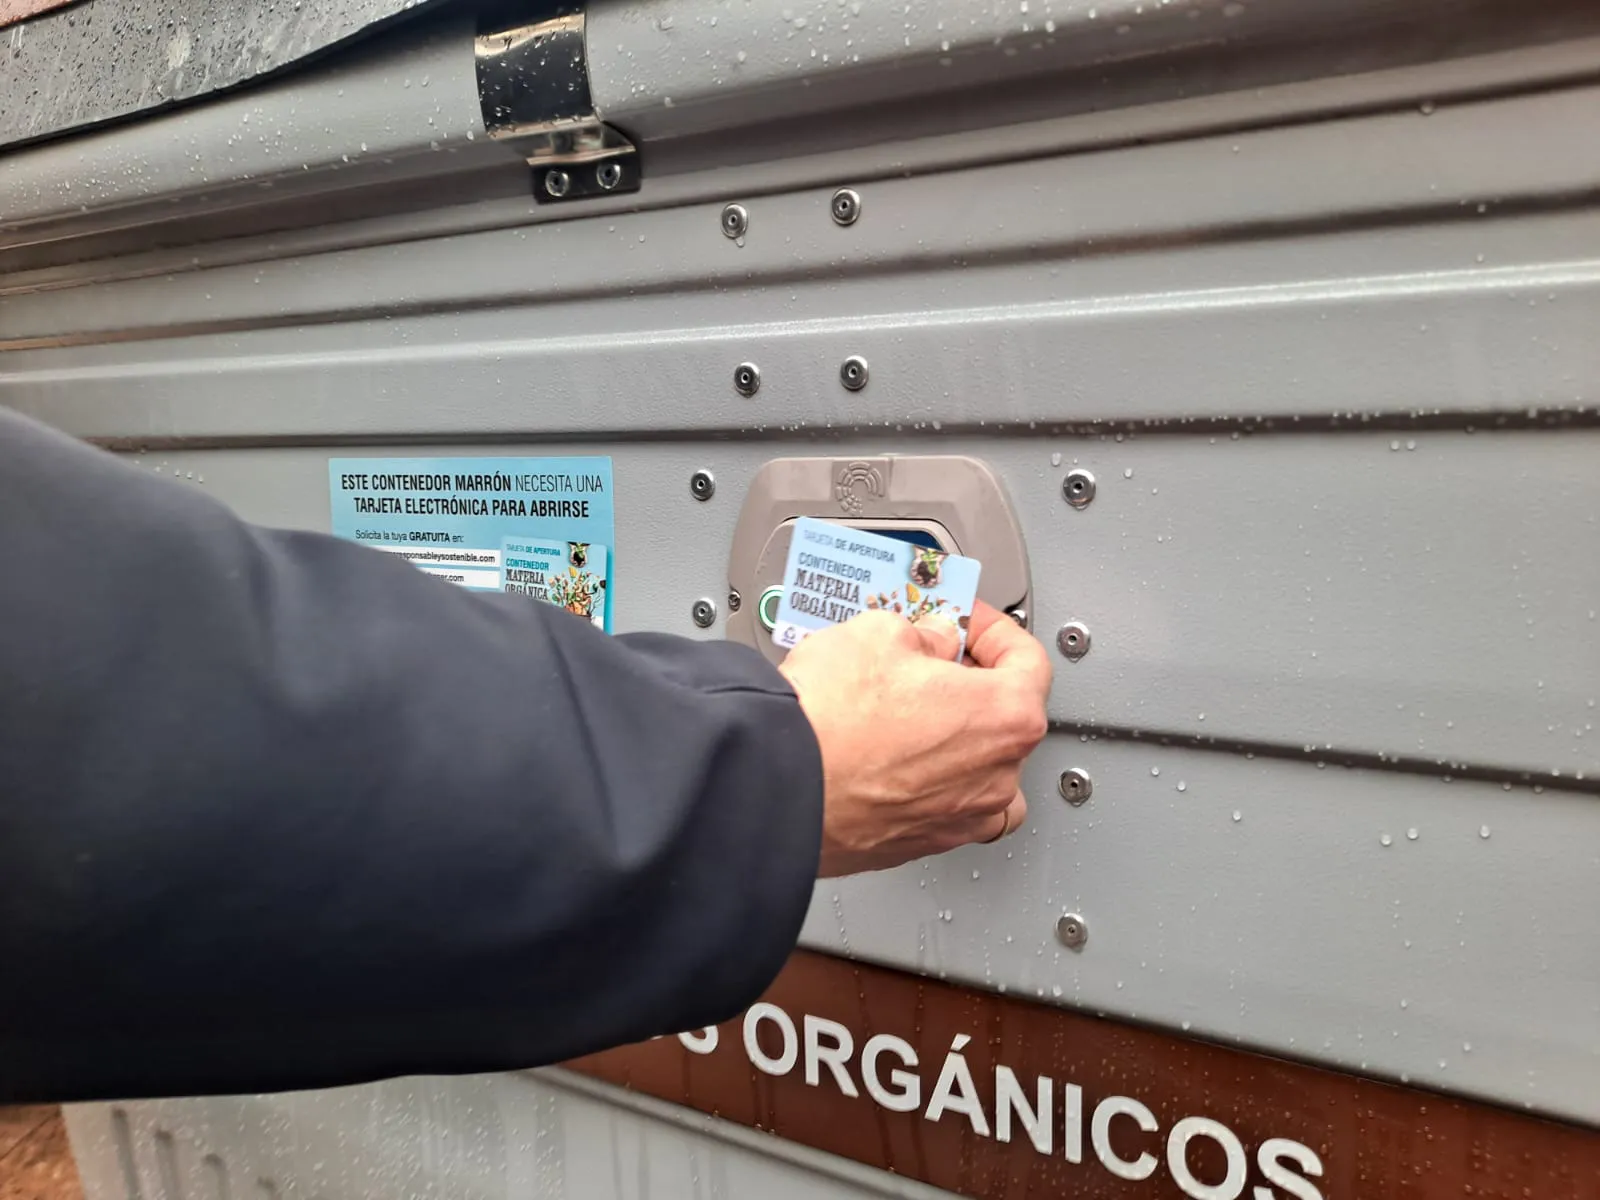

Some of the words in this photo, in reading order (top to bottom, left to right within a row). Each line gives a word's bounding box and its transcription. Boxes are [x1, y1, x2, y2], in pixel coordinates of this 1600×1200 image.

[341, 474, 368, 490] ESTE
[372, 474, 451, 491] CONTENEDOR
[455, 471, 511, 492] MARRÓN
[515, 474, 573, 492] NECESITA
[577, 475, 603, 493] UNA
[354, 497, 401, 514] TARJETA
[405, 495, 488, 516] ELECTRÓNICA
[492, 500, 526, 517] PARA
[530, 501, 589, 518] ABRIRSE
[355, 530, 382, 541] Solicita
[384, 530, 390, 541] la
[391, 531, 407, 544] tuya
[409, 531, 450, 543] GRATUITA
[452, 534, 464, 543] en:
[526, 545, 533, 553] DE
[534, 546, 560, 556] APERTURA
[835, 538, 847, 550] DE
[848, 541, 895, 563] APERTURA
[506, 558, 549, 571] CONTENEDOR
[799, 552, 872, 583] CONTENEDOR
[506, 569, 545, 585] MATERIA
[793, 568, 860, 605] MATERIA
[505, 582, 549, 600] ORGÁNICA
[790, 591, 862, 623] ORGÁNIC
[742, 1002, 1325, 1200] ORGÁNICOS
